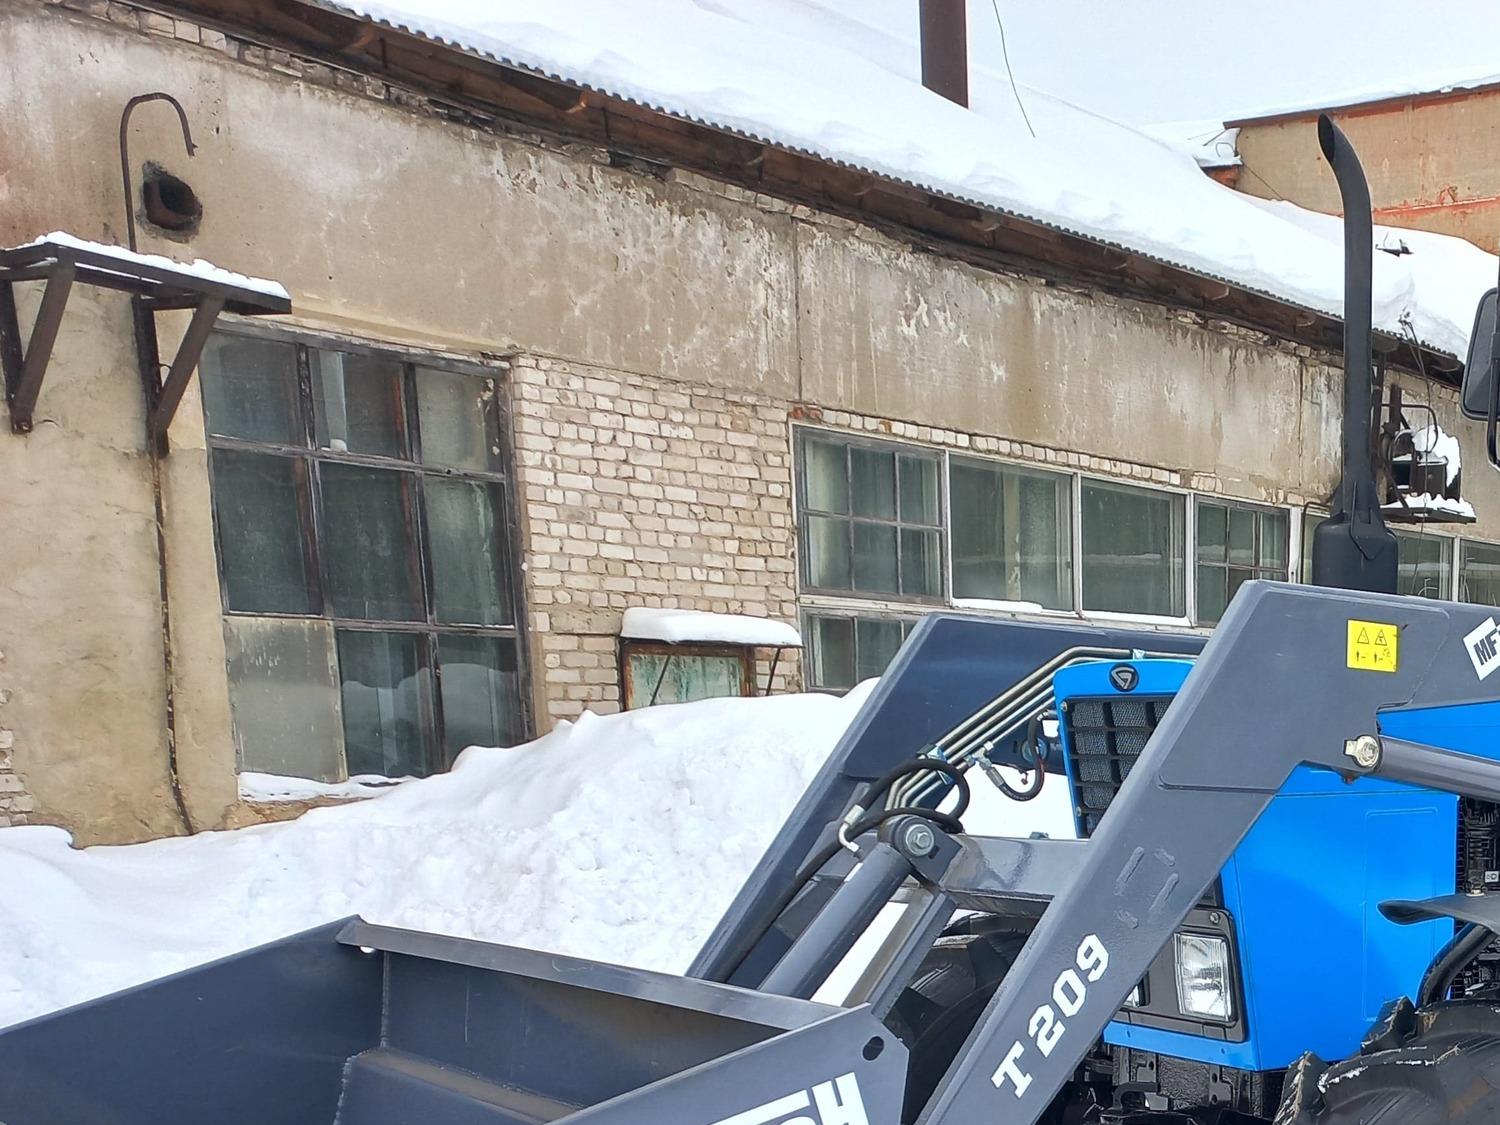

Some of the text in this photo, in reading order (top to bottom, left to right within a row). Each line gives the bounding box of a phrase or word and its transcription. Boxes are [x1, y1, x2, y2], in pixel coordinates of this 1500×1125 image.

[1473, 628, 1498, 667] MF
[991, 934, 1109, 1098] T 209
